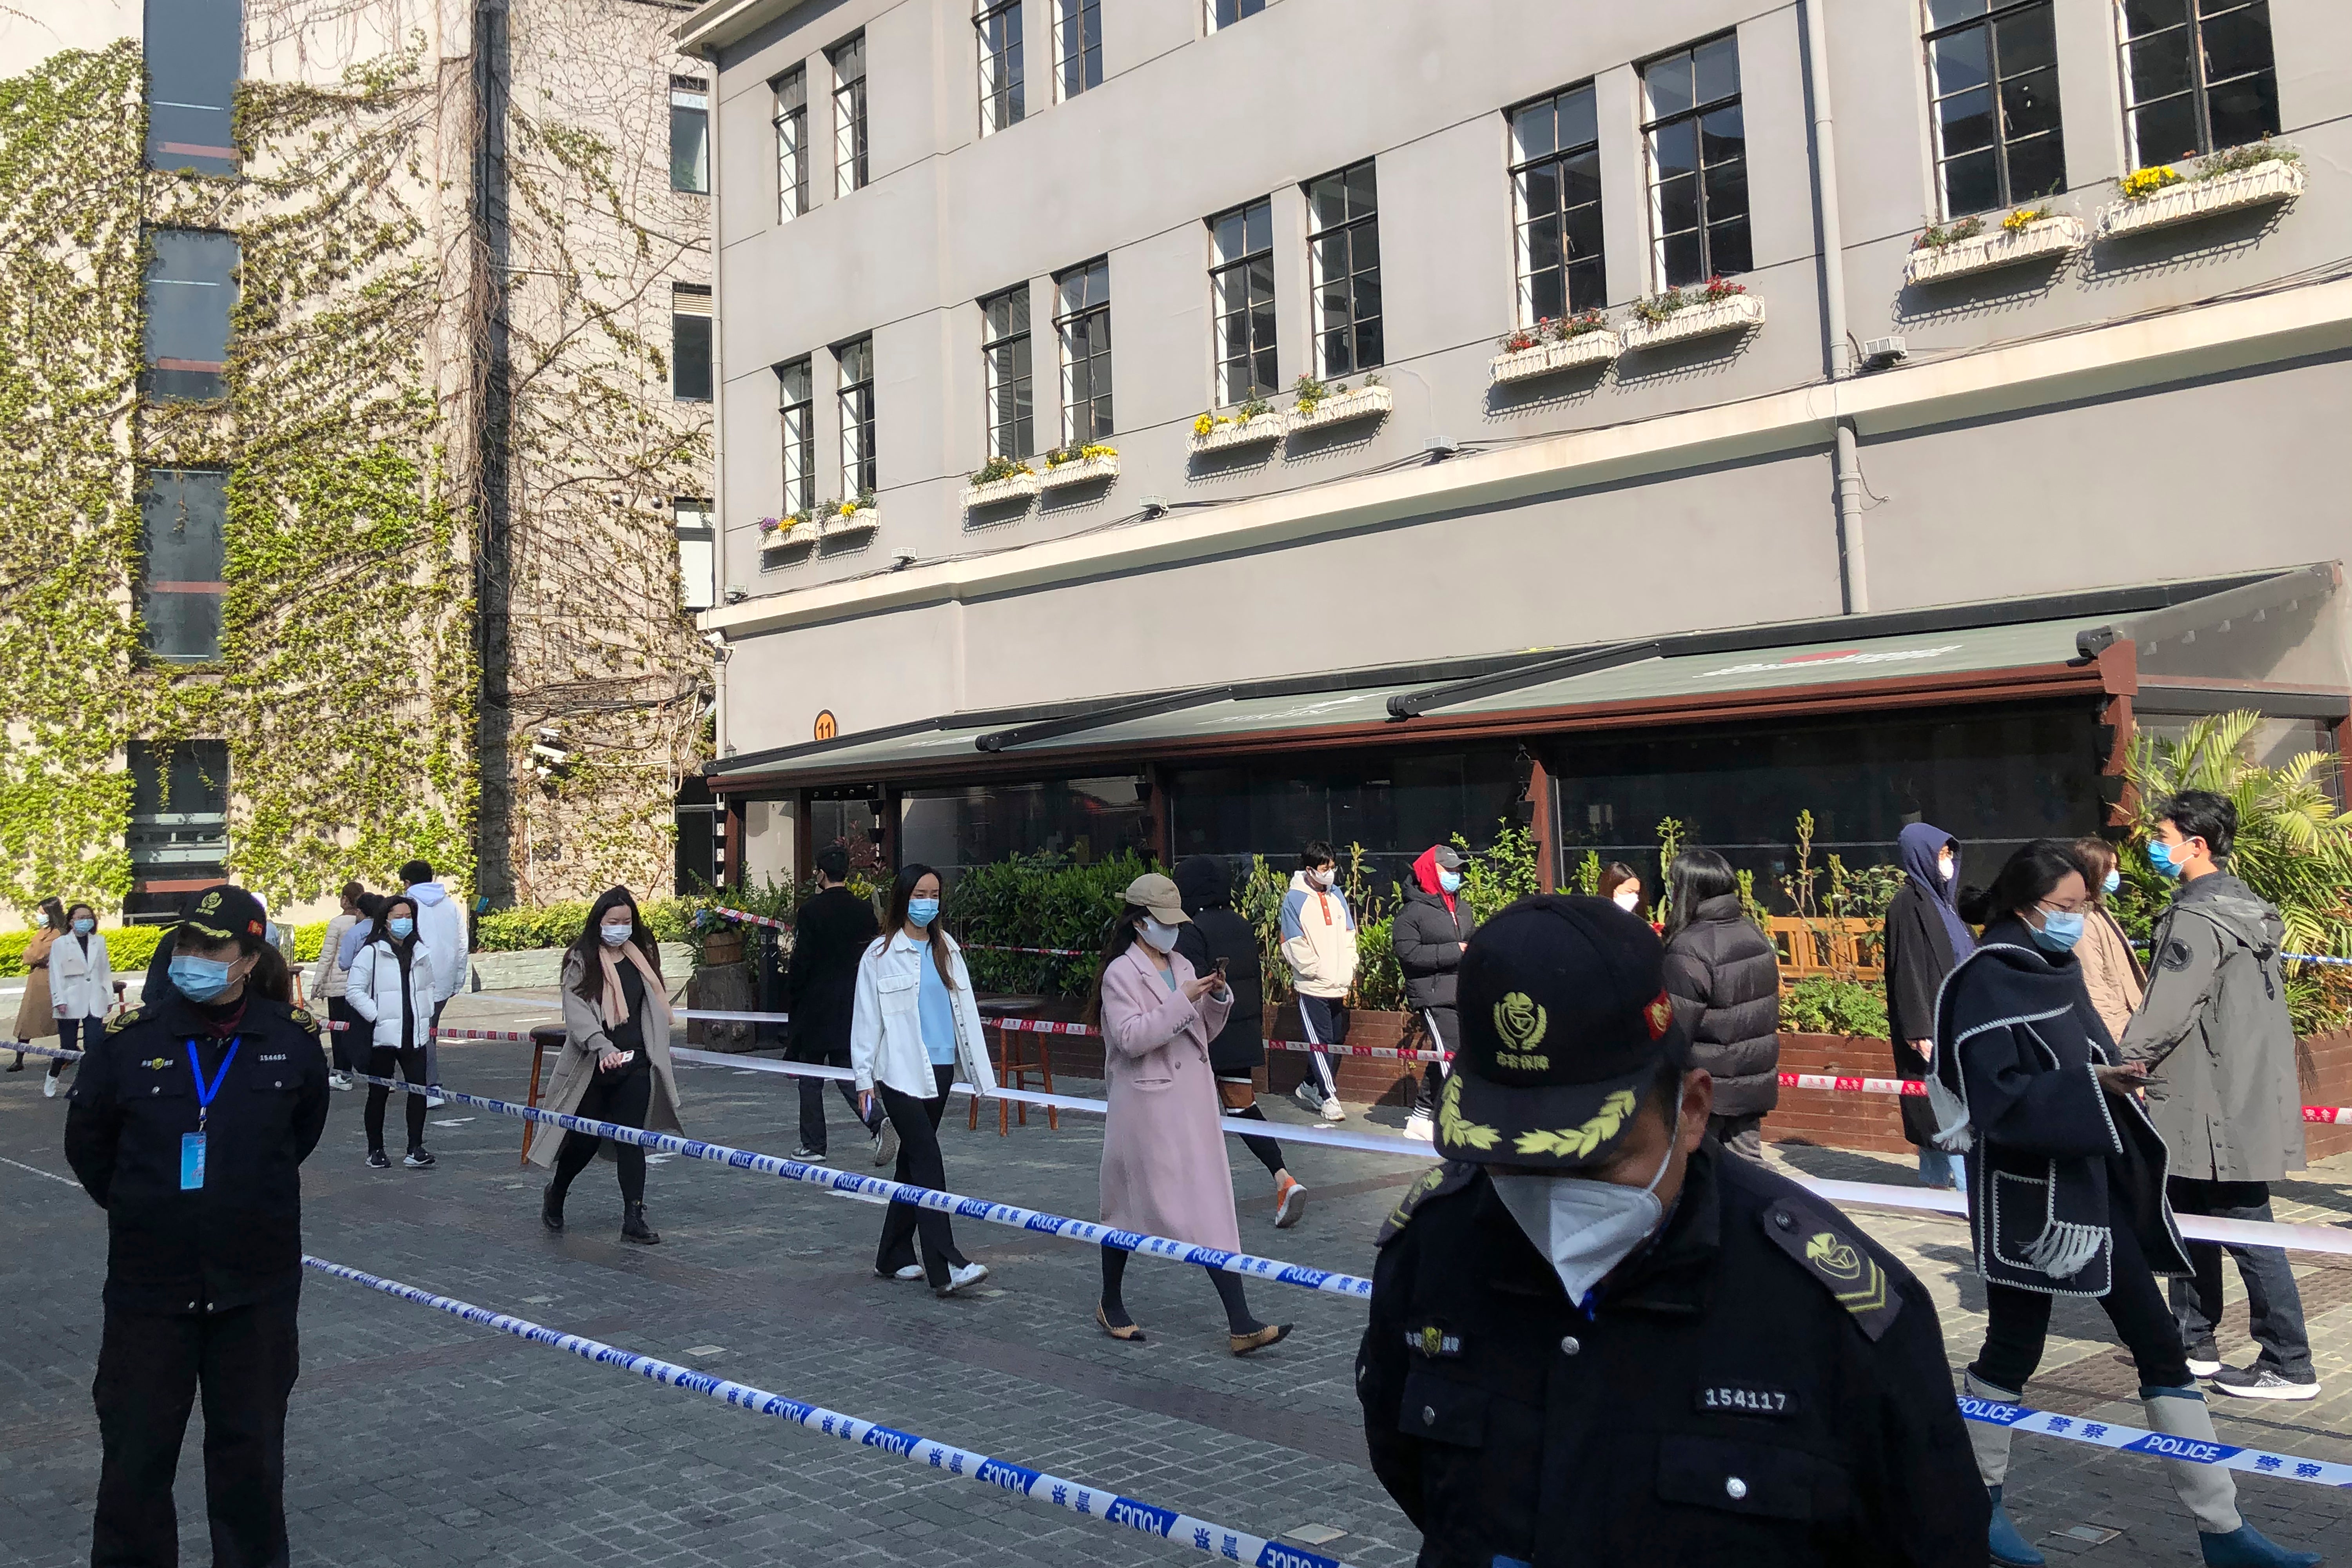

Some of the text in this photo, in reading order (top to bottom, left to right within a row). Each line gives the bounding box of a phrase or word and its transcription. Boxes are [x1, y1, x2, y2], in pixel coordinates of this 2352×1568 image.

[818, 722, 831, 739] 11
[684, 1143, 702, 1156] POLICE
[732, 1152, 750, 1167] POLICE
[784, 1163, 803, 1178] POLICE
[838, 1173, 860, 1189] POLICE
[897, 1185, 922, 1202] POLICE
[961, 1199, 988, 1215] POLICE
[1031, 1214, 1061, 1230] POLICE
[1108, 1230, 1141, 1247] POLICE
[1193, 1248, 1228, 1265] POLICE
[1239, 1257, 1271, 1274] 警察
[1286, 1266, 1325, 1283] POLICE
[771, 1399, 804, 1425] POLICE
[1706, 1388, 1786, 1410] 154117
[871, 1429, 908, 1457] POLICE
[2046, 1416, 2109, 1439] 警察
[2145, 1436, 2220, 1461] POLICE
[2254, 1455, 2322, 1478] 警察
[985, 1463, 1026, 1495] POLICE
[1116, 1503, 1163, 1536] POLICE
[1194, 1528, 1239, 1561] 警察
